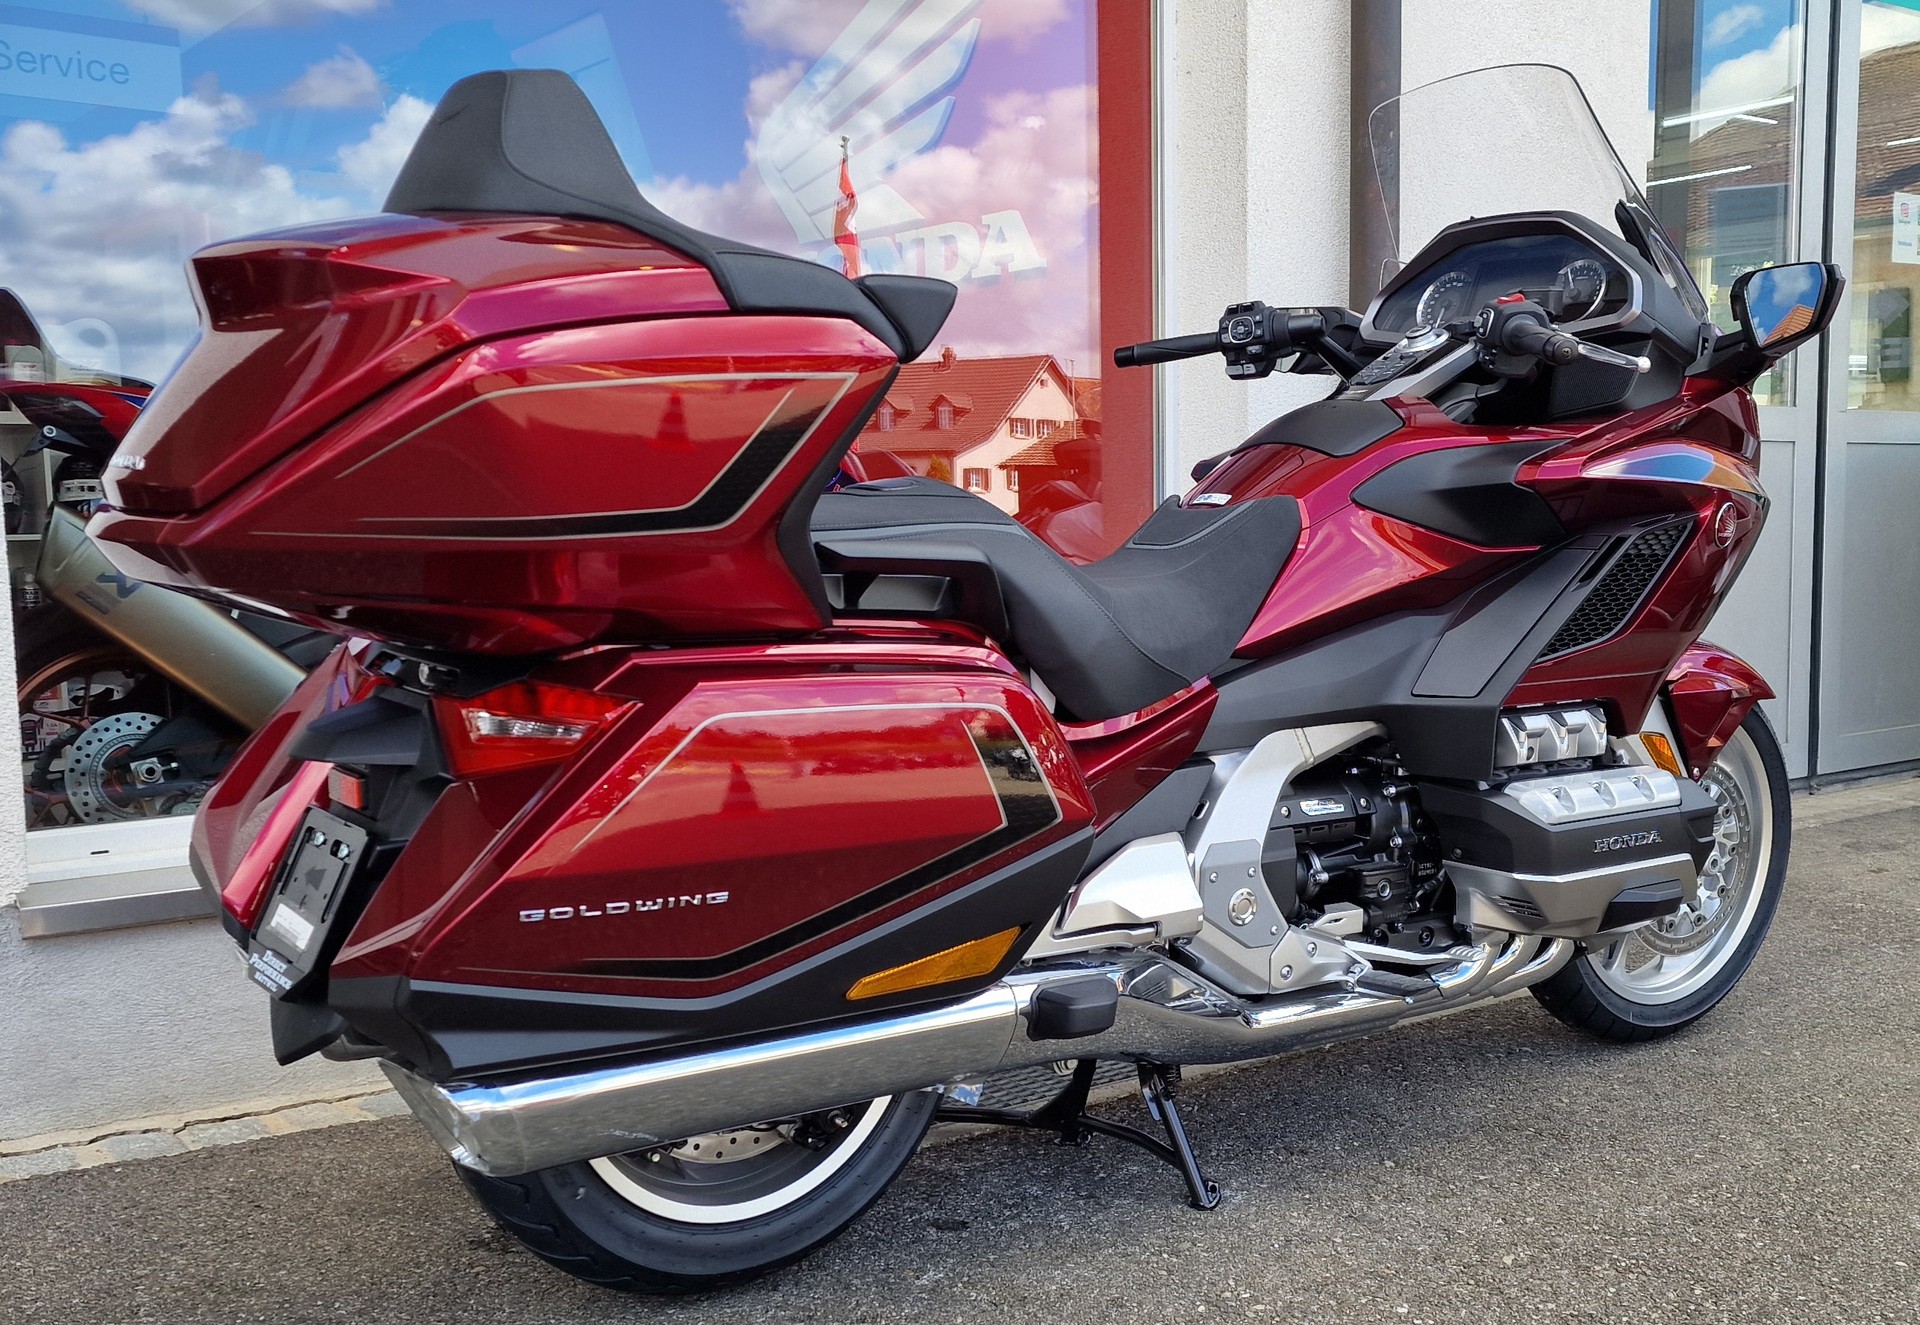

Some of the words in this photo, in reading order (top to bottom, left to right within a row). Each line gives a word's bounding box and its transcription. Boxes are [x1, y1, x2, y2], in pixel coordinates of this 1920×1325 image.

[797, 209, 1047, 282] NDA
[1593, 831, 1662, 853] HONDA
[519, 891, 729, 922] GOLDWING
